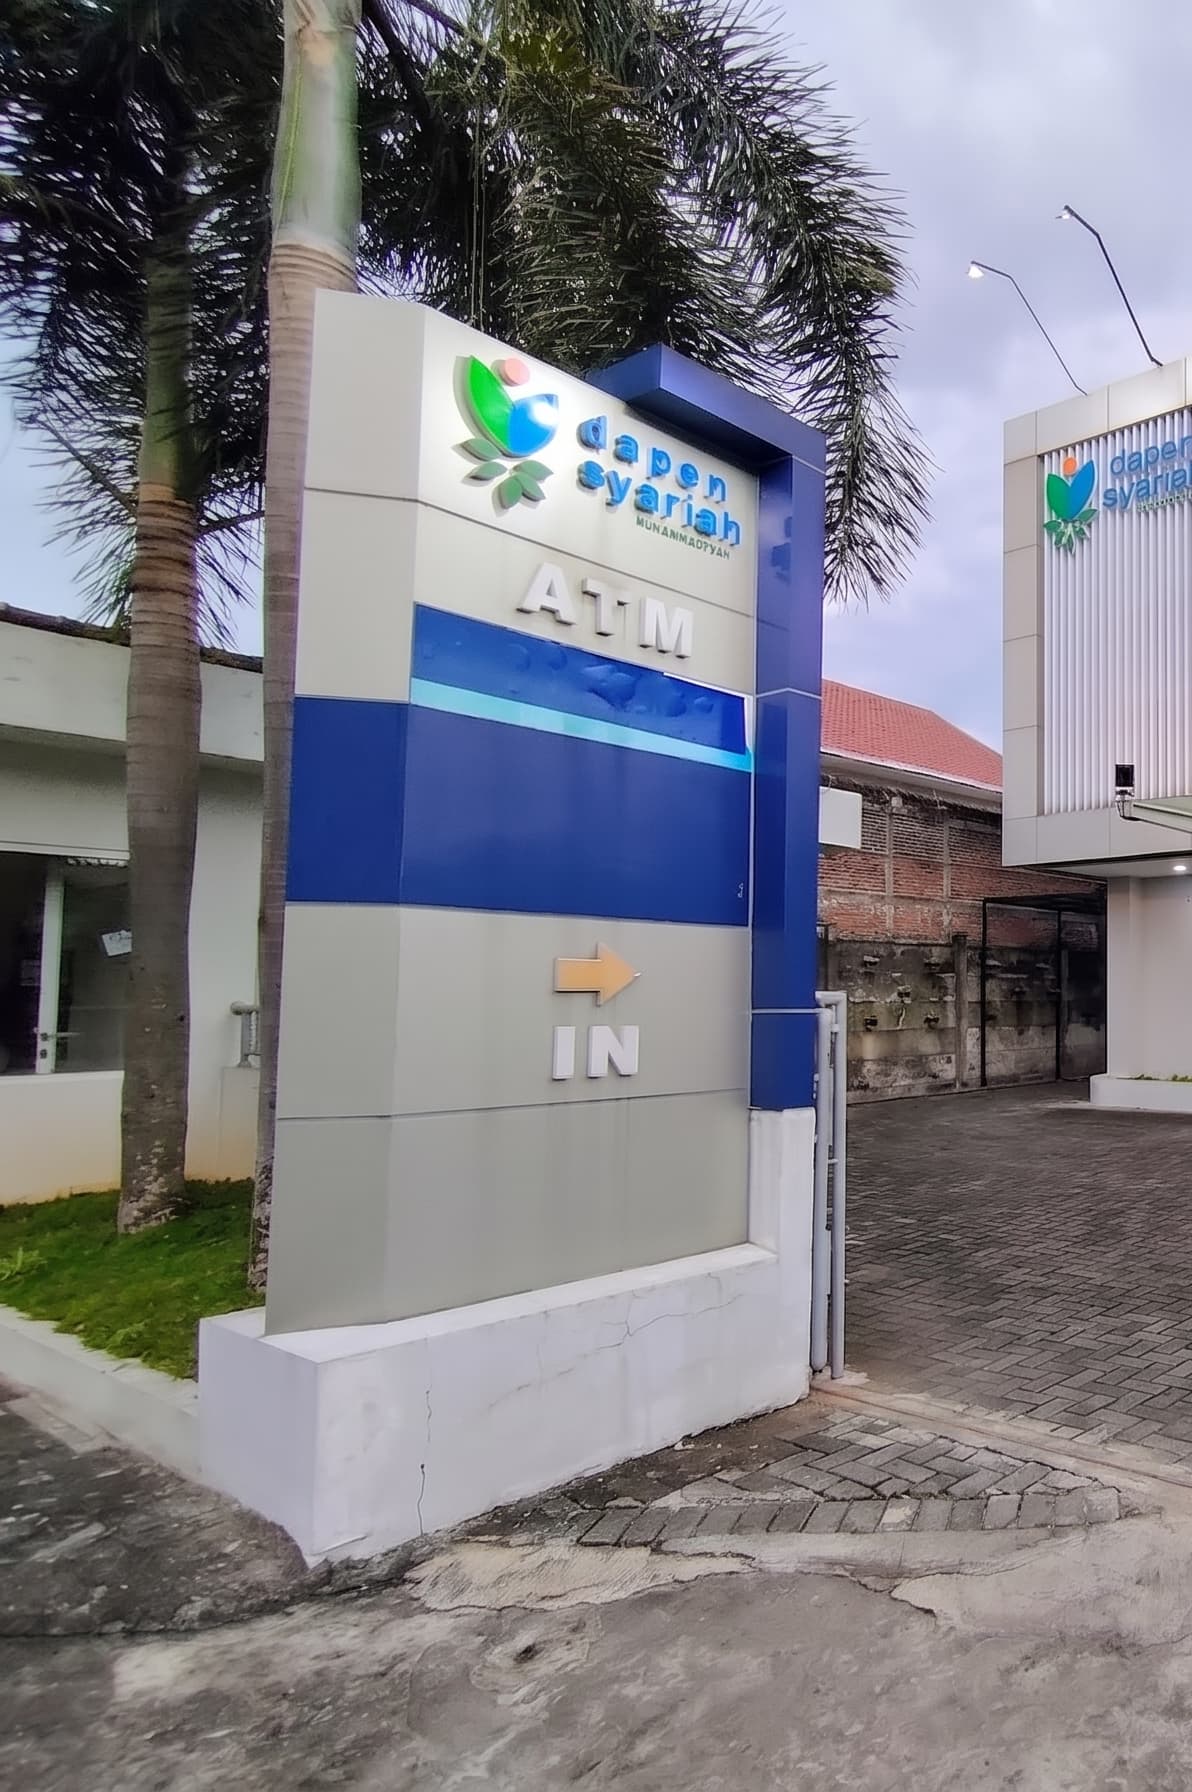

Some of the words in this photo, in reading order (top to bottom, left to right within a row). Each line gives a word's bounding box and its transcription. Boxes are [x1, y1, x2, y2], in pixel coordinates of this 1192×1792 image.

[577, 415, 727, 503] dapen
[577, 460, 741, 546] syariah
[516, 563, 694, 659] ATM
[552, 1024, 639, 1081] IN
